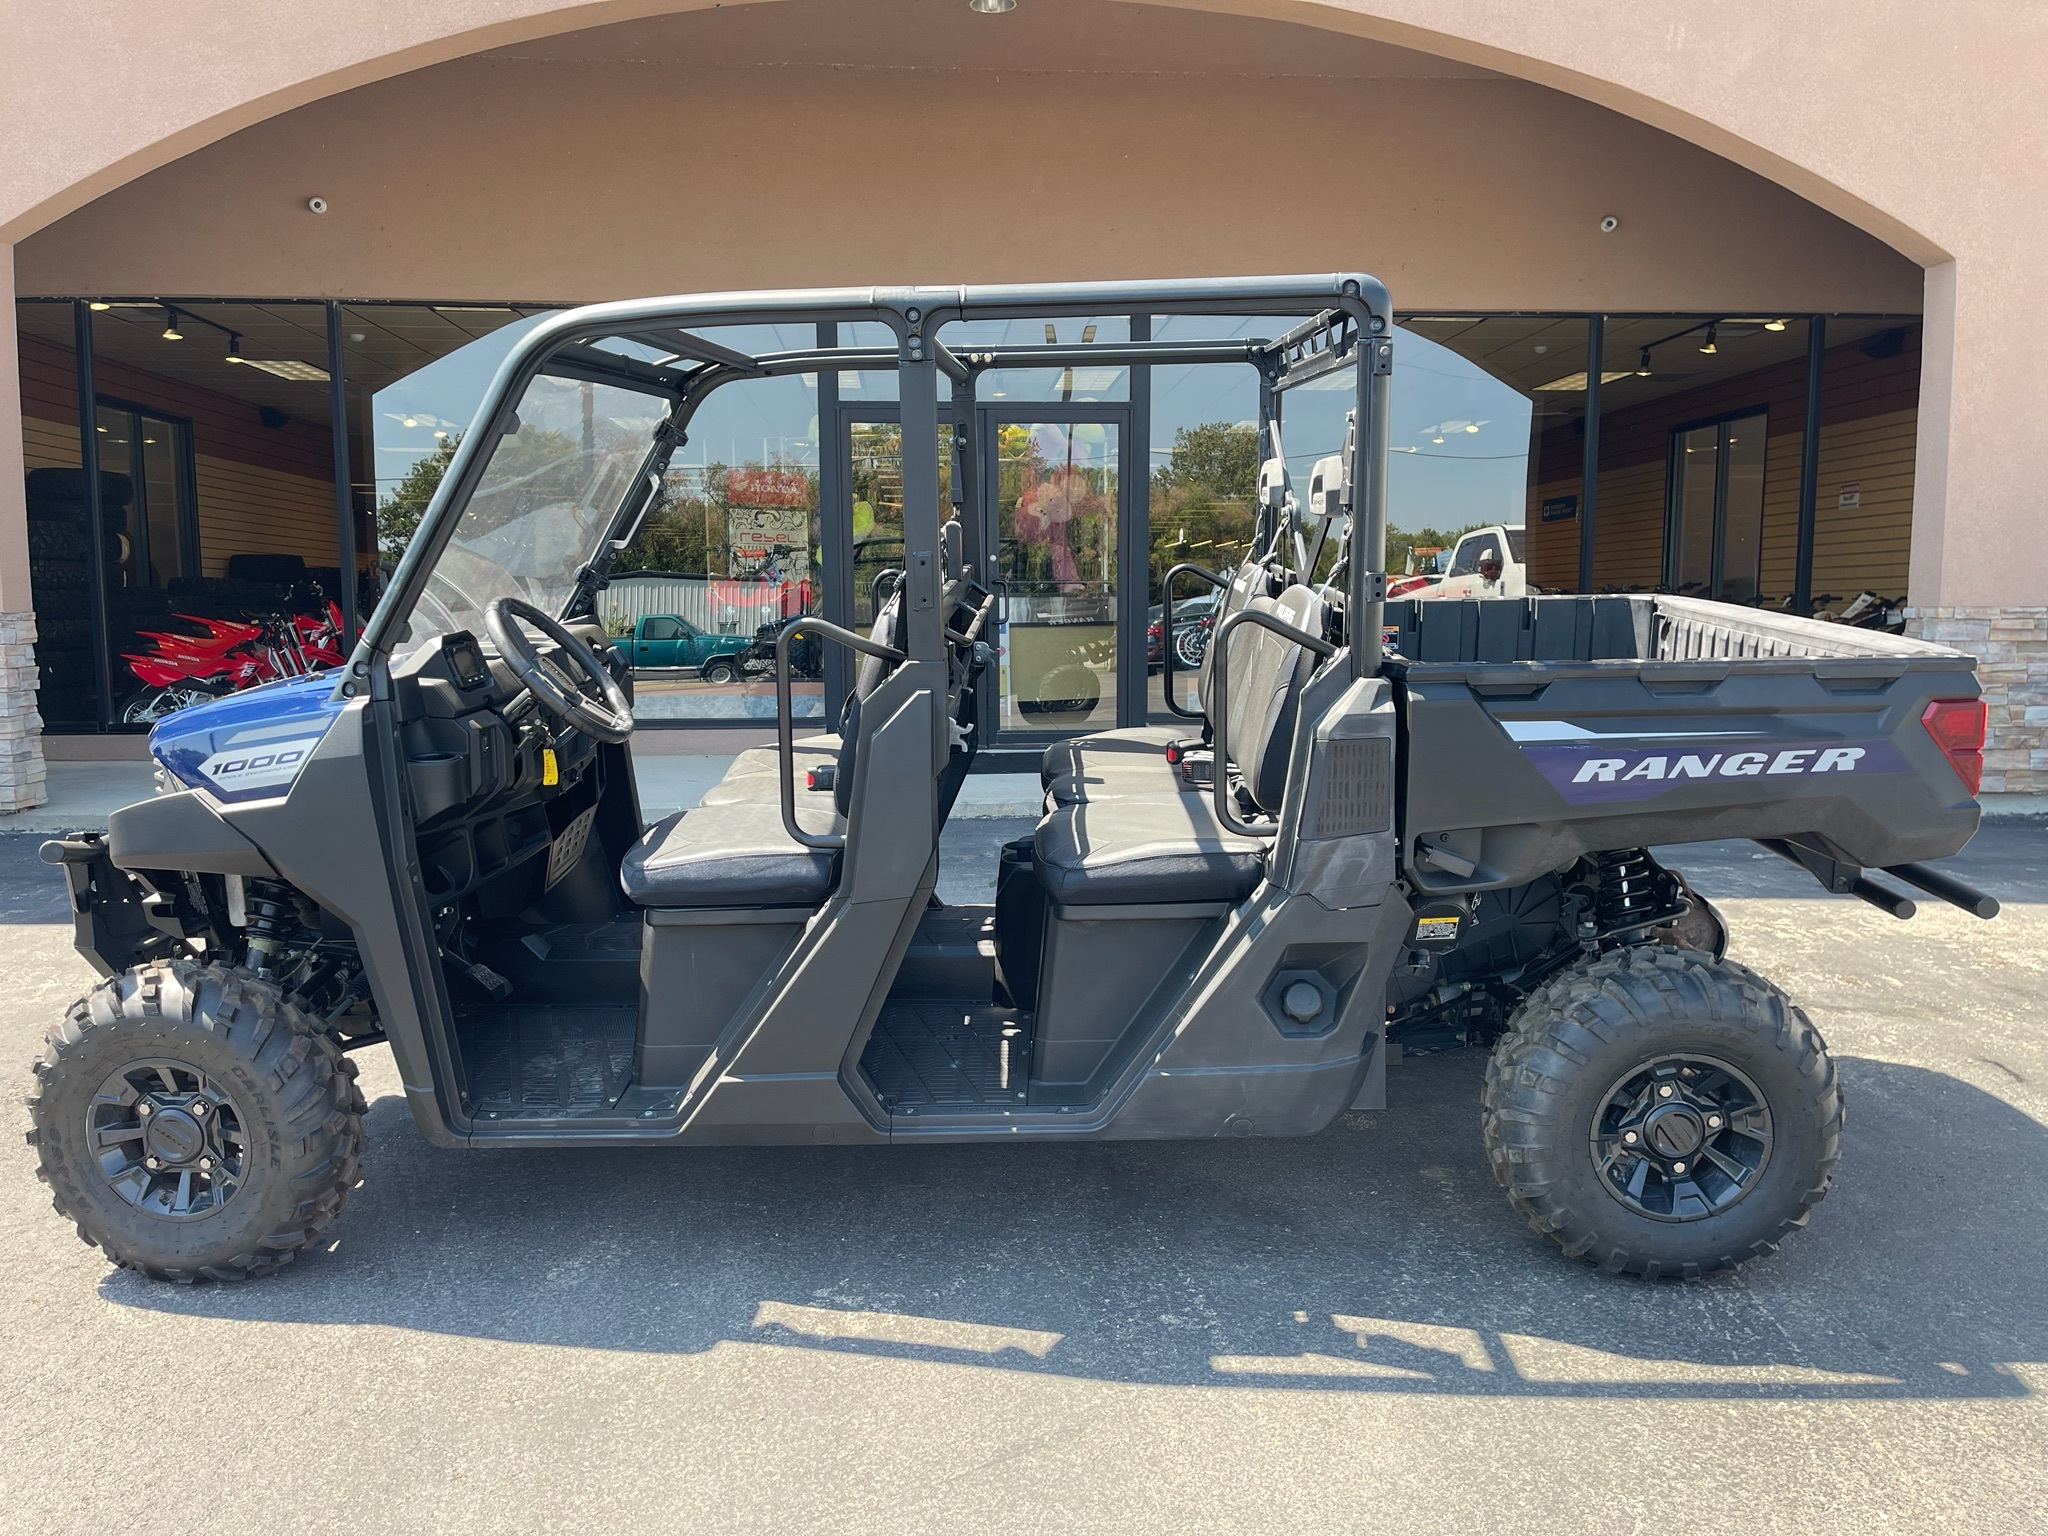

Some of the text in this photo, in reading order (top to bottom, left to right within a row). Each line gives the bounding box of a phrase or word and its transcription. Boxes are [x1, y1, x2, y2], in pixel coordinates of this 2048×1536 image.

[750, 484, 801, 493] HONDA
[225, 620, 246, 630] HONDA
[173, 634, 195, 643] HONDA
[154, 657, 179, 667] HONDA
[177, 653, 200, 662] HONDA
[212, 750, 304, 776] 1000
[1571, 747, 1866, 783] RANGER
[231, 1066, 281, 1171] CARLISLE
